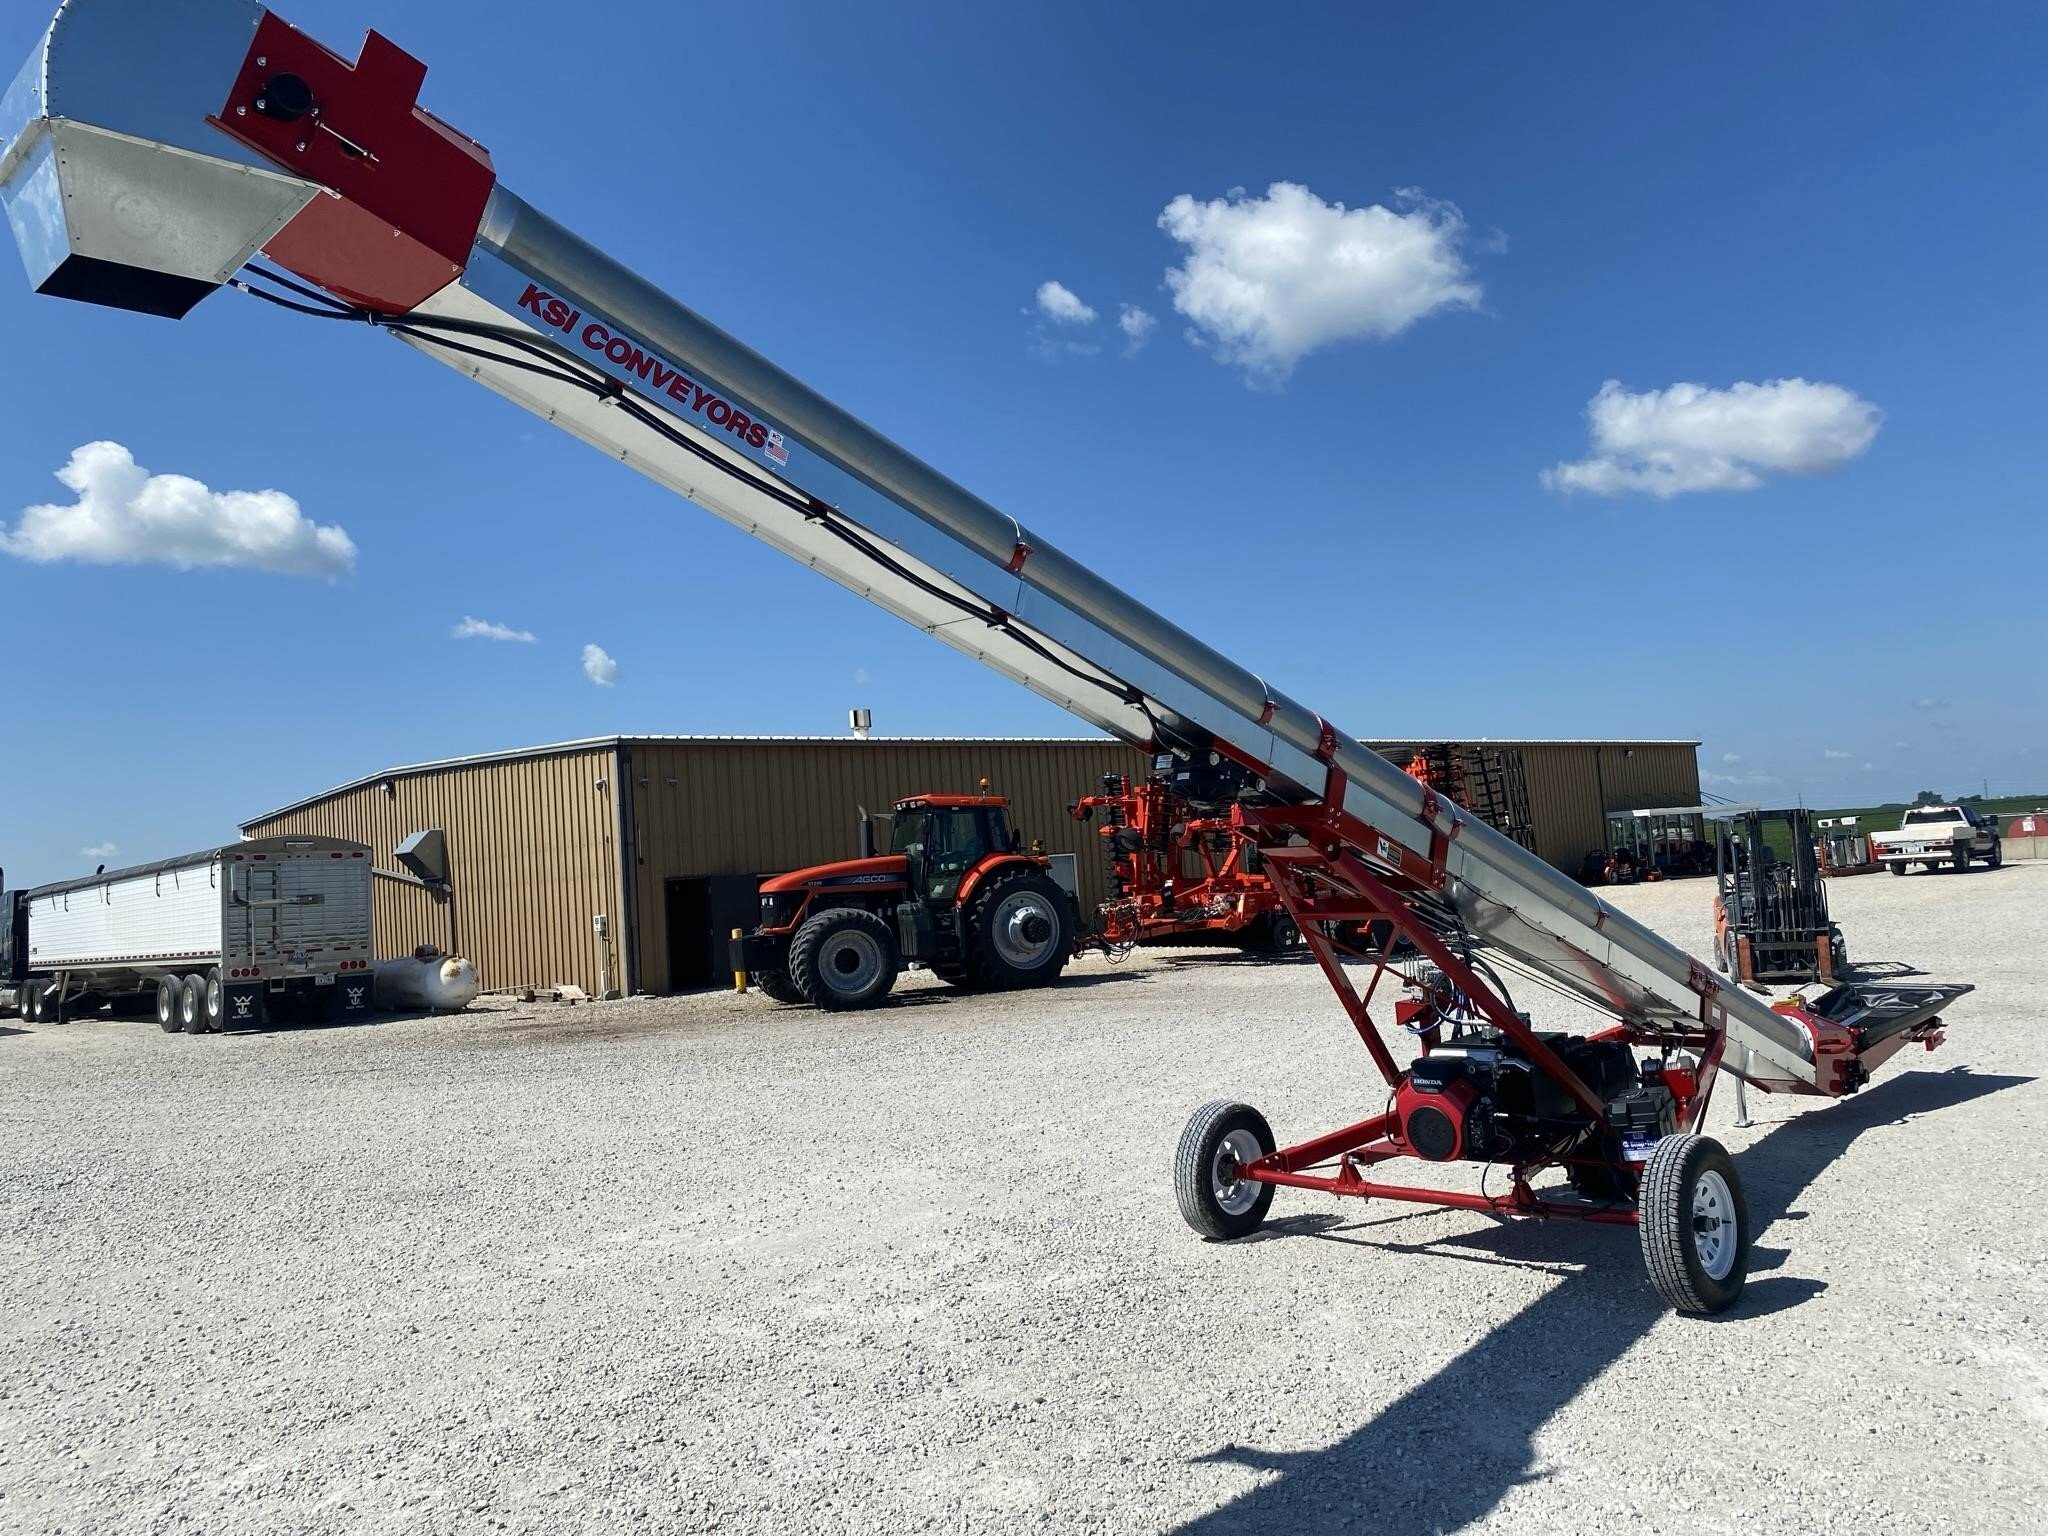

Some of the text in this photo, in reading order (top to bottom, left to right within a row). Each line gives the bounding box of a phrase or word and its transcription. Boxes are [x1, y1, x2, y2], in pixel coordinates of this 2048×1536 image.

[518, 283, 581, 334] KSI
[582, 323, 769, 448] CONVEYORS
[852, 875, 885, 884] AGCO
